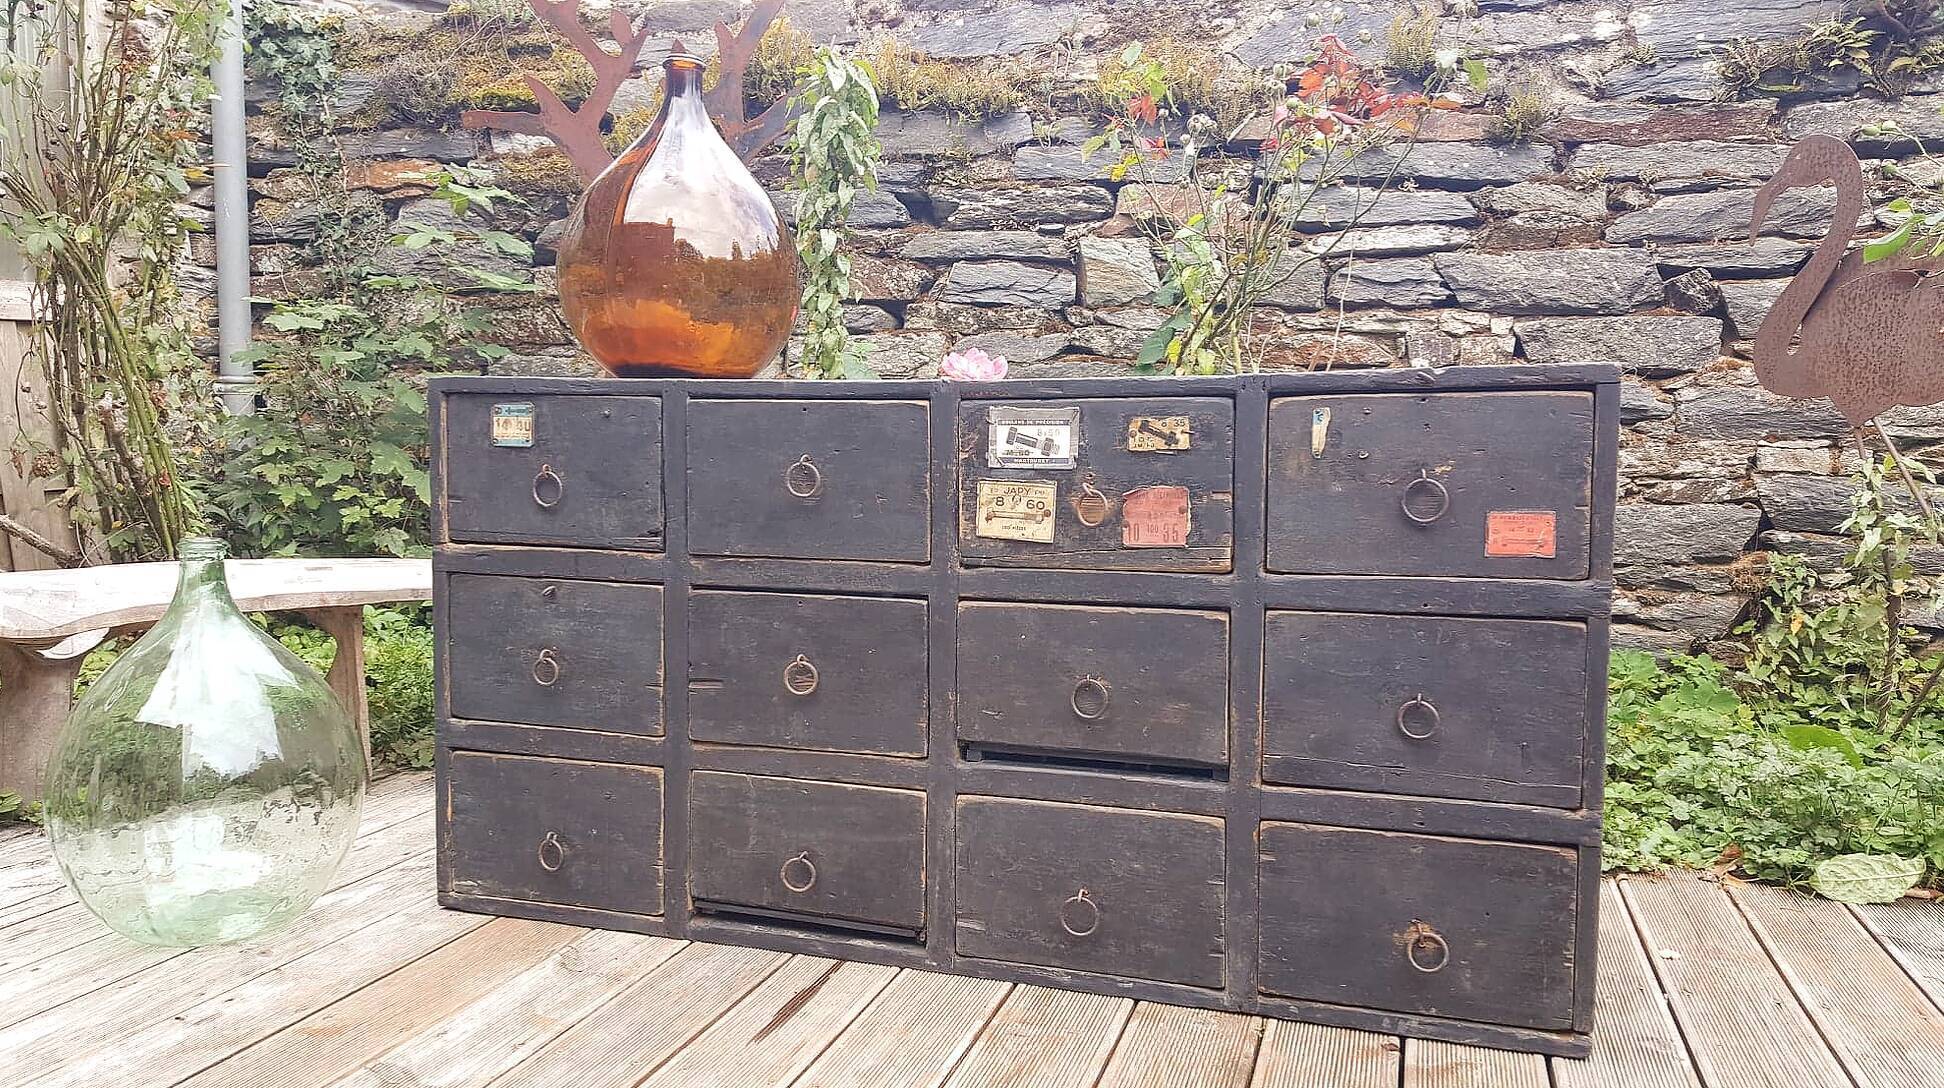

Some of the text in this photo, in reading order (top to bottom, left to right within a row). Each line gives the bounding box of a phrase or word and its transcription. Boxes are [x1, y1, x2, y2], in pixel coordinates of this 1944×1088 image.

[1003, 486, 1032, 496] JAPY
[995, 496, 1046, 511] 8 60
